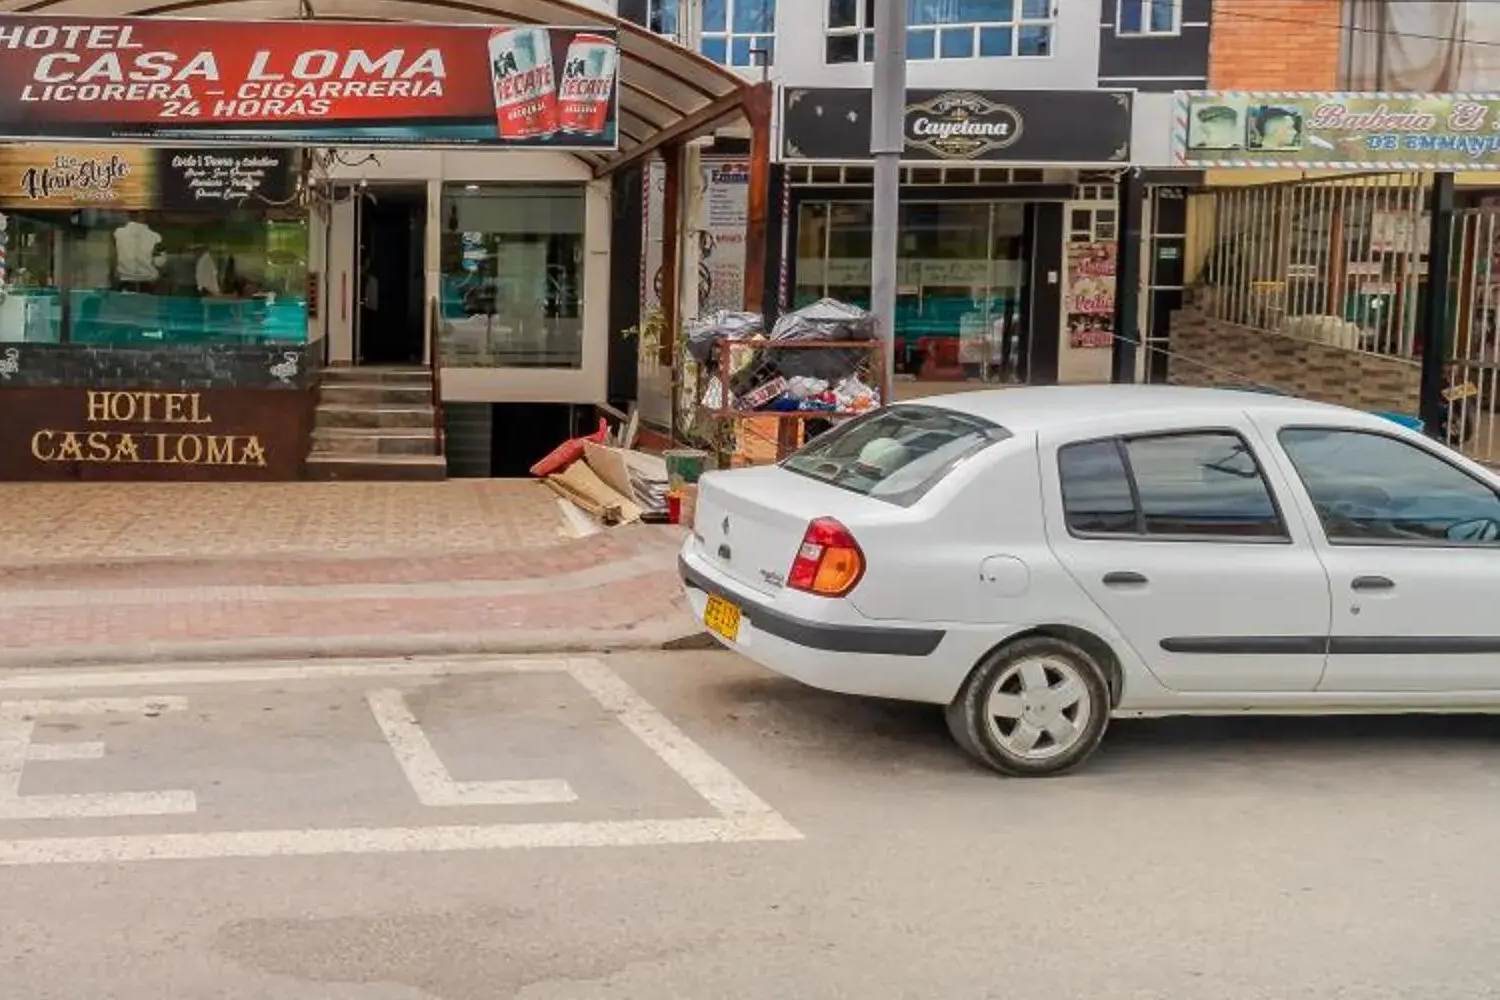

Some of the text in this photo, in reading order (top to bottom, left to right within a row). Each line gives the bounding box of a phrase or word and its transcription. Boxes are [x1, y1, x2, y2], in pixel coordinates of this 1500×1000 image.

[33, 48, 447, 83] CASA LOMA
[19, 82, 193, 102] LICORERA
[236, 80, 444, 100] CIGARRERIA
[158, 99, 331, 118] 24 HORAS
[912, 116, 1009, 138] Cayetana
[1366, 134, 1398, 150] DE
[87, 390, 213, 424] HOTEL
[31, 428, 267, 467] CASA LOMA
